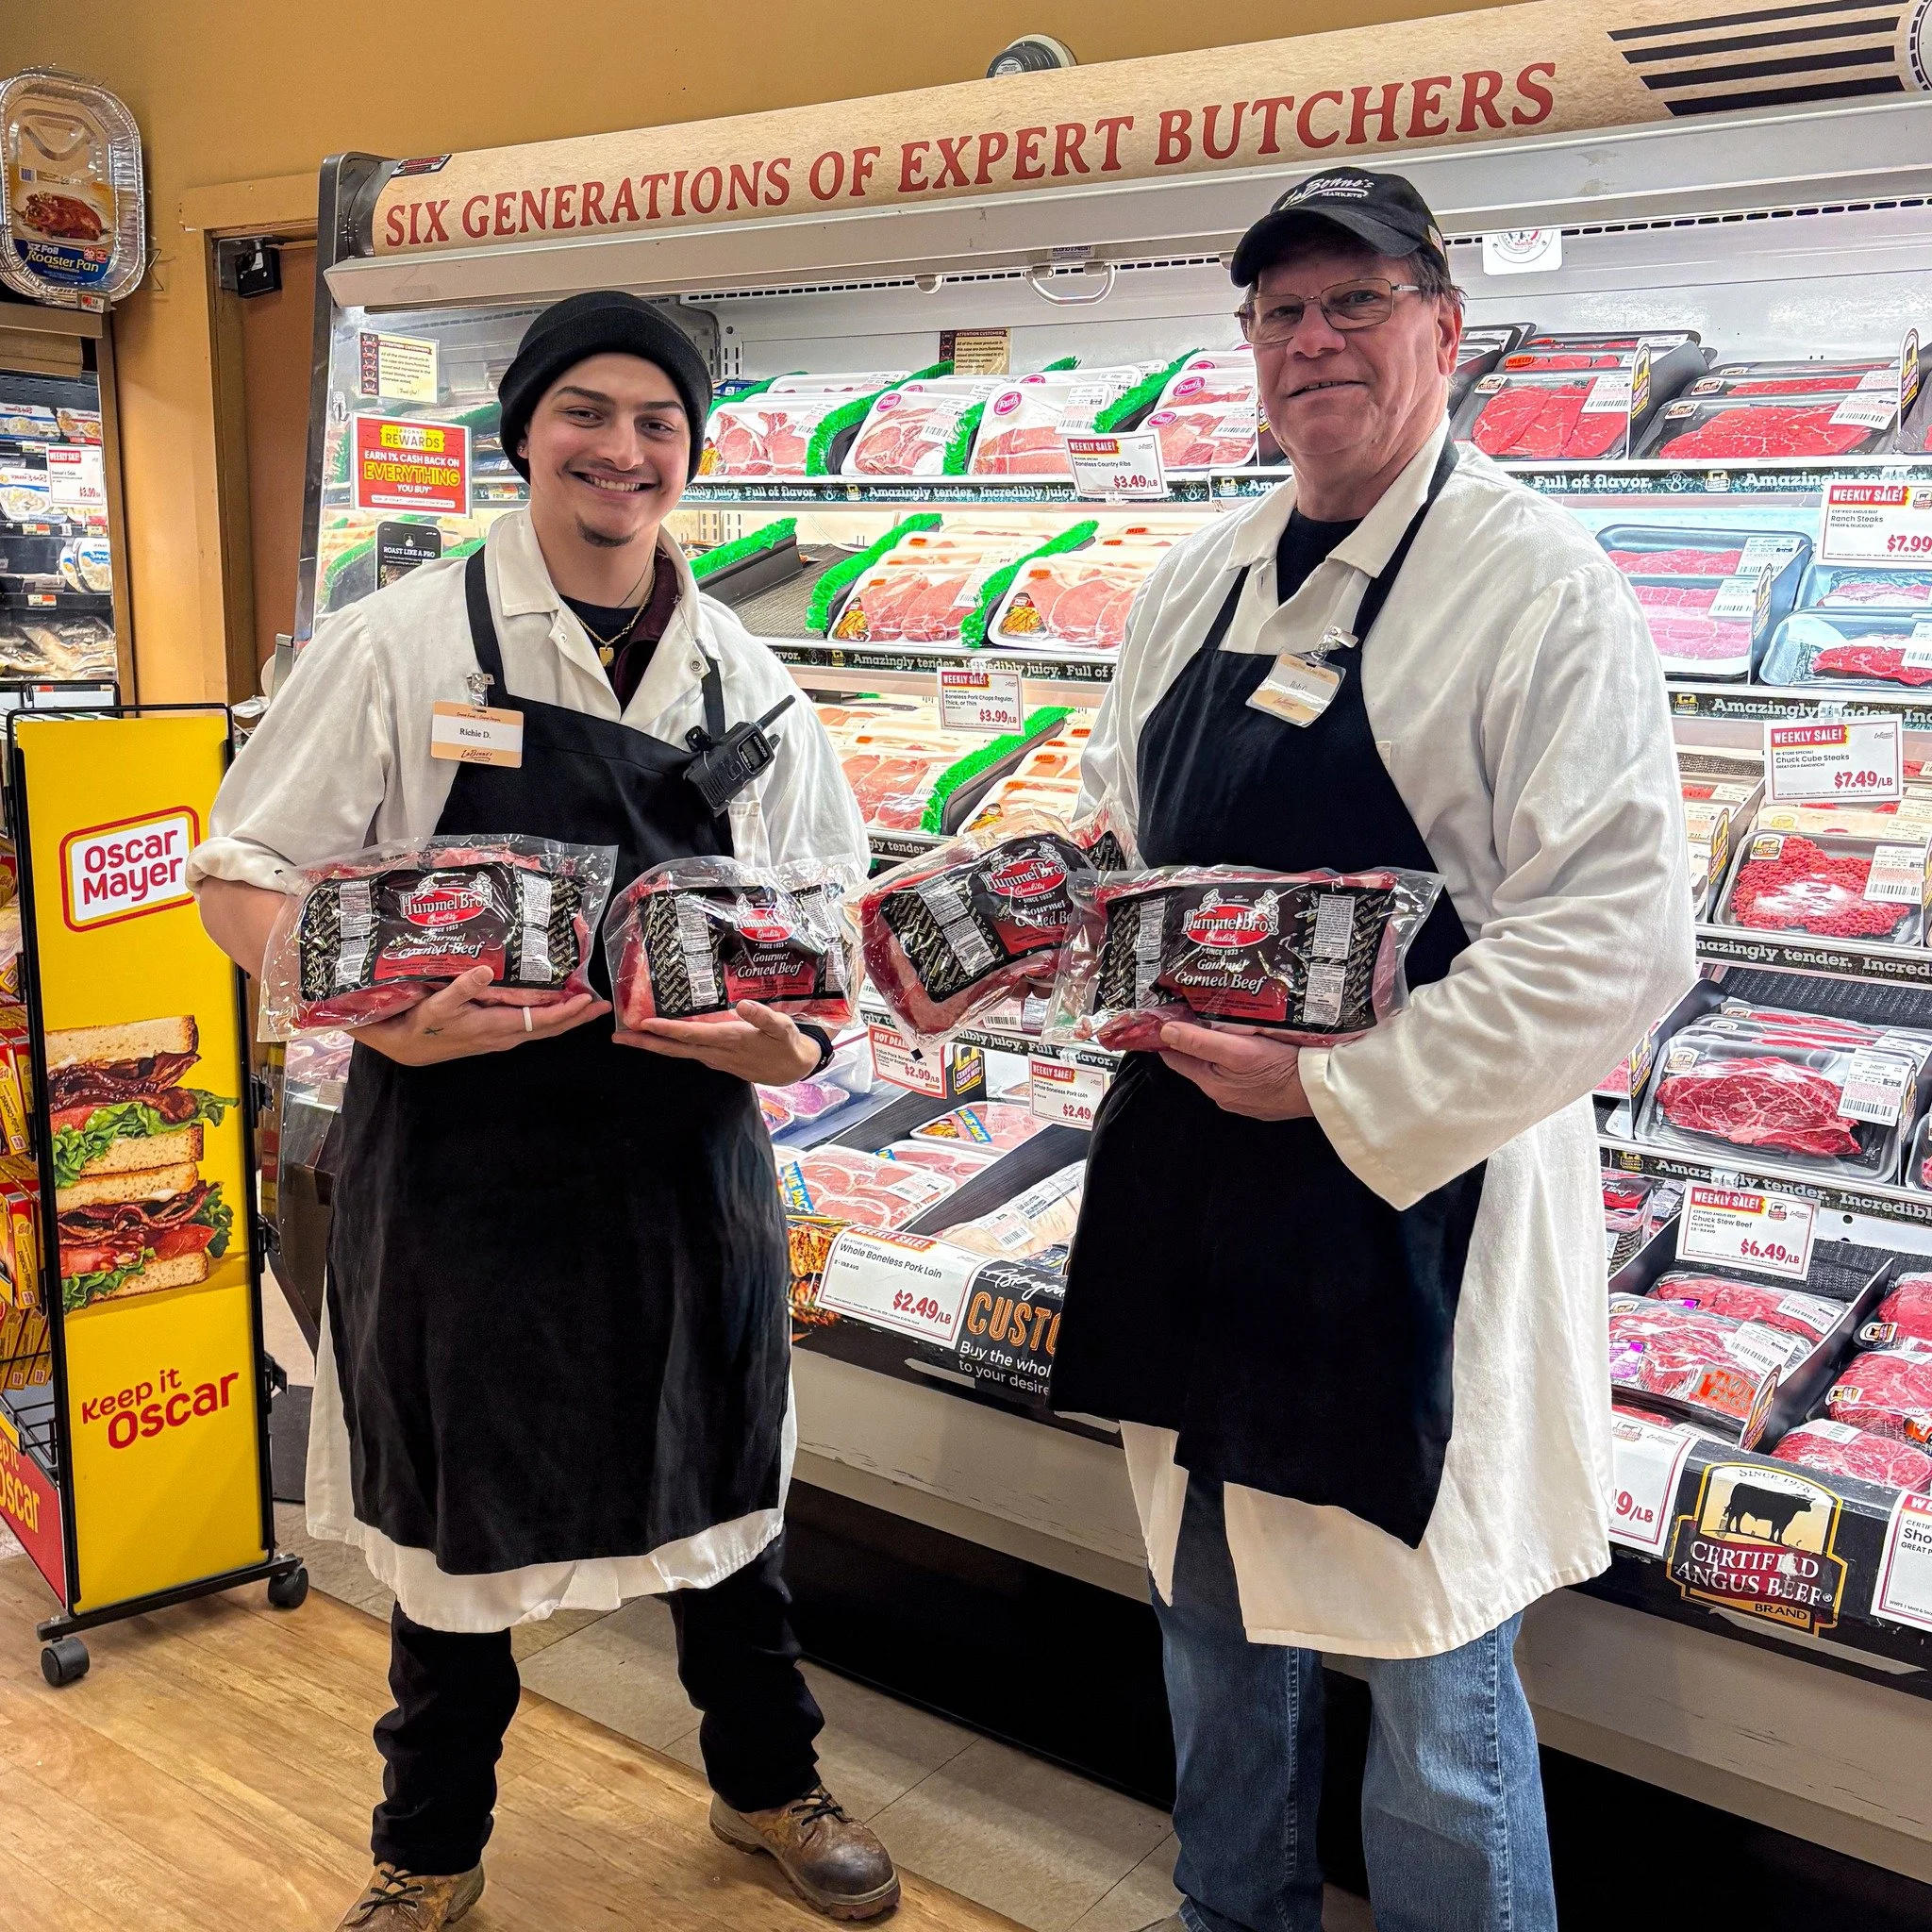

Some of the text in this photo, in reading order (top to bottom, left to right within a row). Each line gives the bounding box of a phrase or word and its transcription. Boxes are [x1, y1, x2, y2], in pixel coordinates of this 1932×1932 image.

[385, 62, 1557, 246] SIX GENERATIONS OF EXPERT BUTCHERS
[42, 245, 58, 255] Foil
[28, 250, 99, 273] Roaster Pan
[385, 434, 440, 449] REWARDS
[1070, 441, 1116, 451] WEEKLY SALE!
[364, 451, 459, 467] EARN 1% CASH BACK ON
[364, 461, 460, 488] EVERYTHING
[1114, 475, 1158, 489] $3.49/LB
[1534, 475, 1652, 489] Full of flavor.
[397, 484, 413, 492] YOU
[713, 487, 816, 501] juicy. Full of flavor.
[868, 487, 931, 501] Amazingly
[936, 486, 974, 498] tender.
[979, 485, 1044, 501] Incredibly
[1833, 490, 1903, 501] WEEKLY SALE!
[853, 653, 1108, 677] Amazingly tender. juicy. Full of
[943, 675, 986, 684] WEEKLY SALE!
[979, 709, 1017, 724] $3.99/LB
[1711, 698, 1821, 719] Amazingly
[460, 728, 481, 738] Richie
[1774, 728, 1842, 743] WEEKLY SALE!
[1834, 771, 1893, 789] $7.49/LB
[84, 829, 177, 874] Oscar
[887, 841, 927, 854] tender.
[83, 858, 183, 905] Mayer
[978, 863, 1040, 892] Hummel
[1015, 882, 1045, 895] Quality
[399, 891, 458, 918] Hummel
[1181, 909, 1242, 934] Hummel
[421, 933, 466, 942] Gourmet
[757, 930, 780, 939] Quality
[1205, 931, 1239, 944] Quality
[398, 941, 485, 958] Corned Beef
[753, 952, 791, 962] Gourmet
[1696, 937, 1932, 977] mazingly tender. Incred
[738, 960, 804, 978] Corned Beef
[1197, 958, 1249, 973] Gourmet
[1174, 972, 1267, 994] Corned Beef
[874, 1032, 889, 1042] HOT
[991, 1035, 1053, 1055] juicy. Full
[905, 1063, 940, 1083] $2.99/LB
[1033, 1065, 1072, 1079] WEEKLY SALE!
[1607, 1187, 1632, 1198] Beef
[1694, 1192, 1759, 1209] WEEKLY SALE!
[1763, 1182, 1932, 1221] tender. Incredibl
[1692, 1215, 1715, 1224] Chuck
[1736, 1220, 1753, 1228] Beef
[854, 1226, 930, 1249] WEEKLY SALE!
[1740, 1239, 1800, 1264] $6.49/LB
[840, 1243, 942, 1278] Whole Boneless Pork Loin
[1021, 1281, 1066, 1302] you
[892, 1289, 952, 1324] $2.49/LB
[959, 1341, 1052, 1378] Buy the whol
[958, 1359, 973, 1373] to
[975, 1365, 1006, 1383] your
[81, 1368, 182, 1424] Keep it
[1709, 1387, 1750, 1410] PACK
[108, 1372, 240, 1449] Oscar
[1739, 1469, 1812, 1493] SINCE 1978
[1614, 1490, 1655, 1523] 9/LB
[1906, 1519, 1932, 1530] CERTIF
[1904, 1528, 1932, 1544] Sho
[1901, 1541, 1927, 1555] GREAT
[1675, 1560, 1760, 1594] ANGUS
[1755, 1604, 1807, 1620] BRAND
